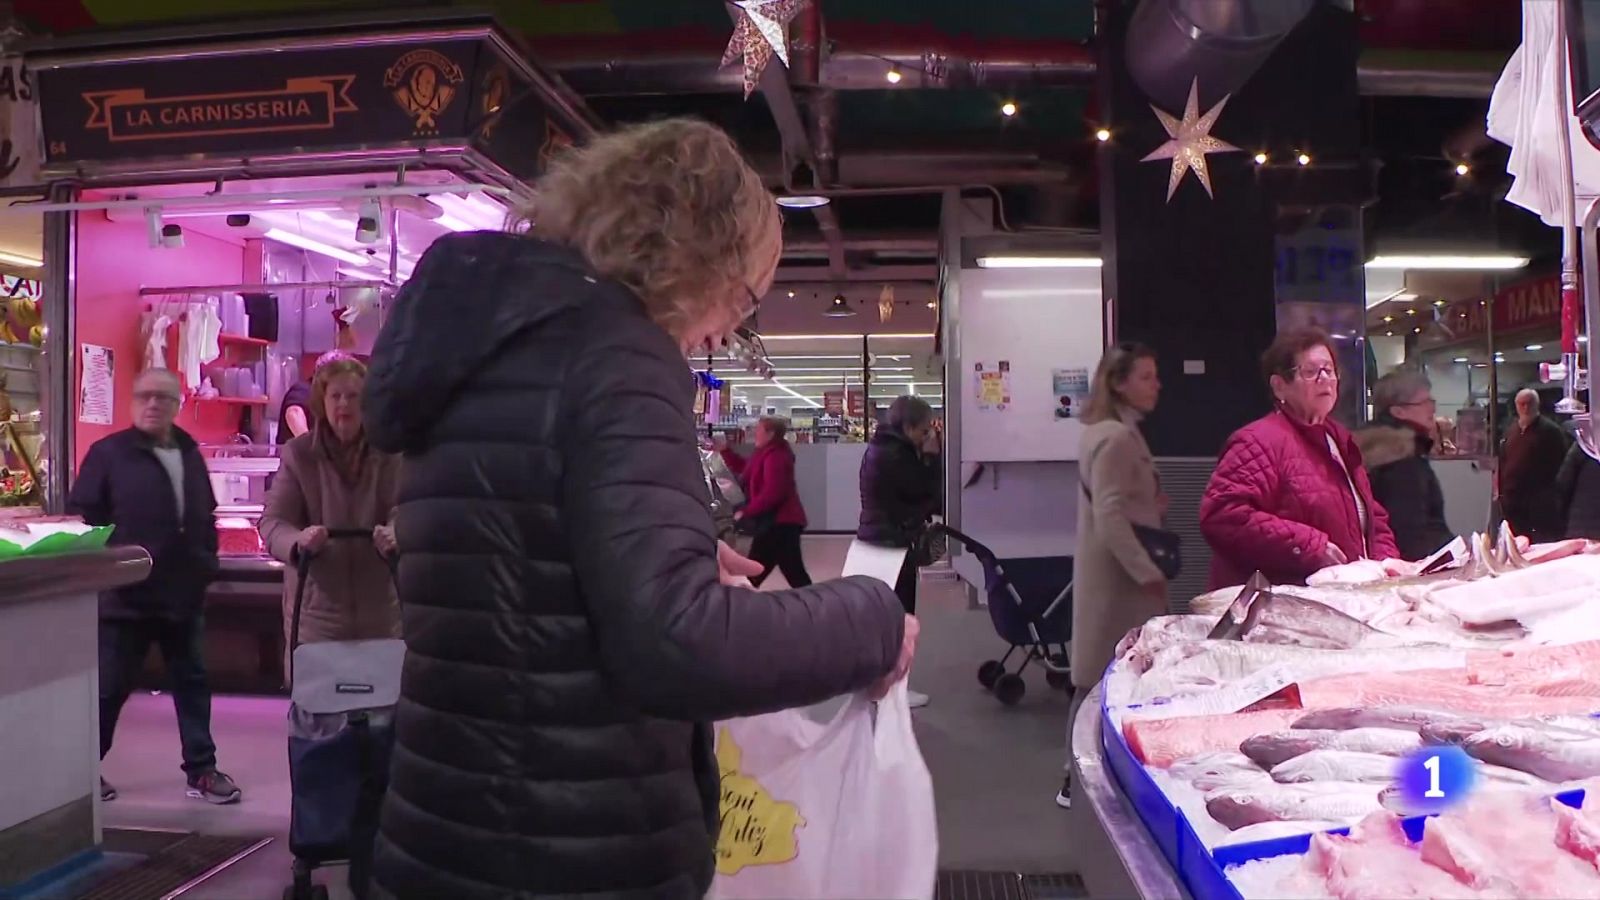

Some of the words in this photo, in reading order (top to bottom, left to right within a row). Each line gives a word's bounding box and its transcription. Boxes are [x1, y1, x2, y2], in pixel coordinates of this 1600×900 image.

[126, 109, 153, 127] LA
[159, 99, 311, 125] CARNISSERIA
[49, 140, 67, 156] 64
